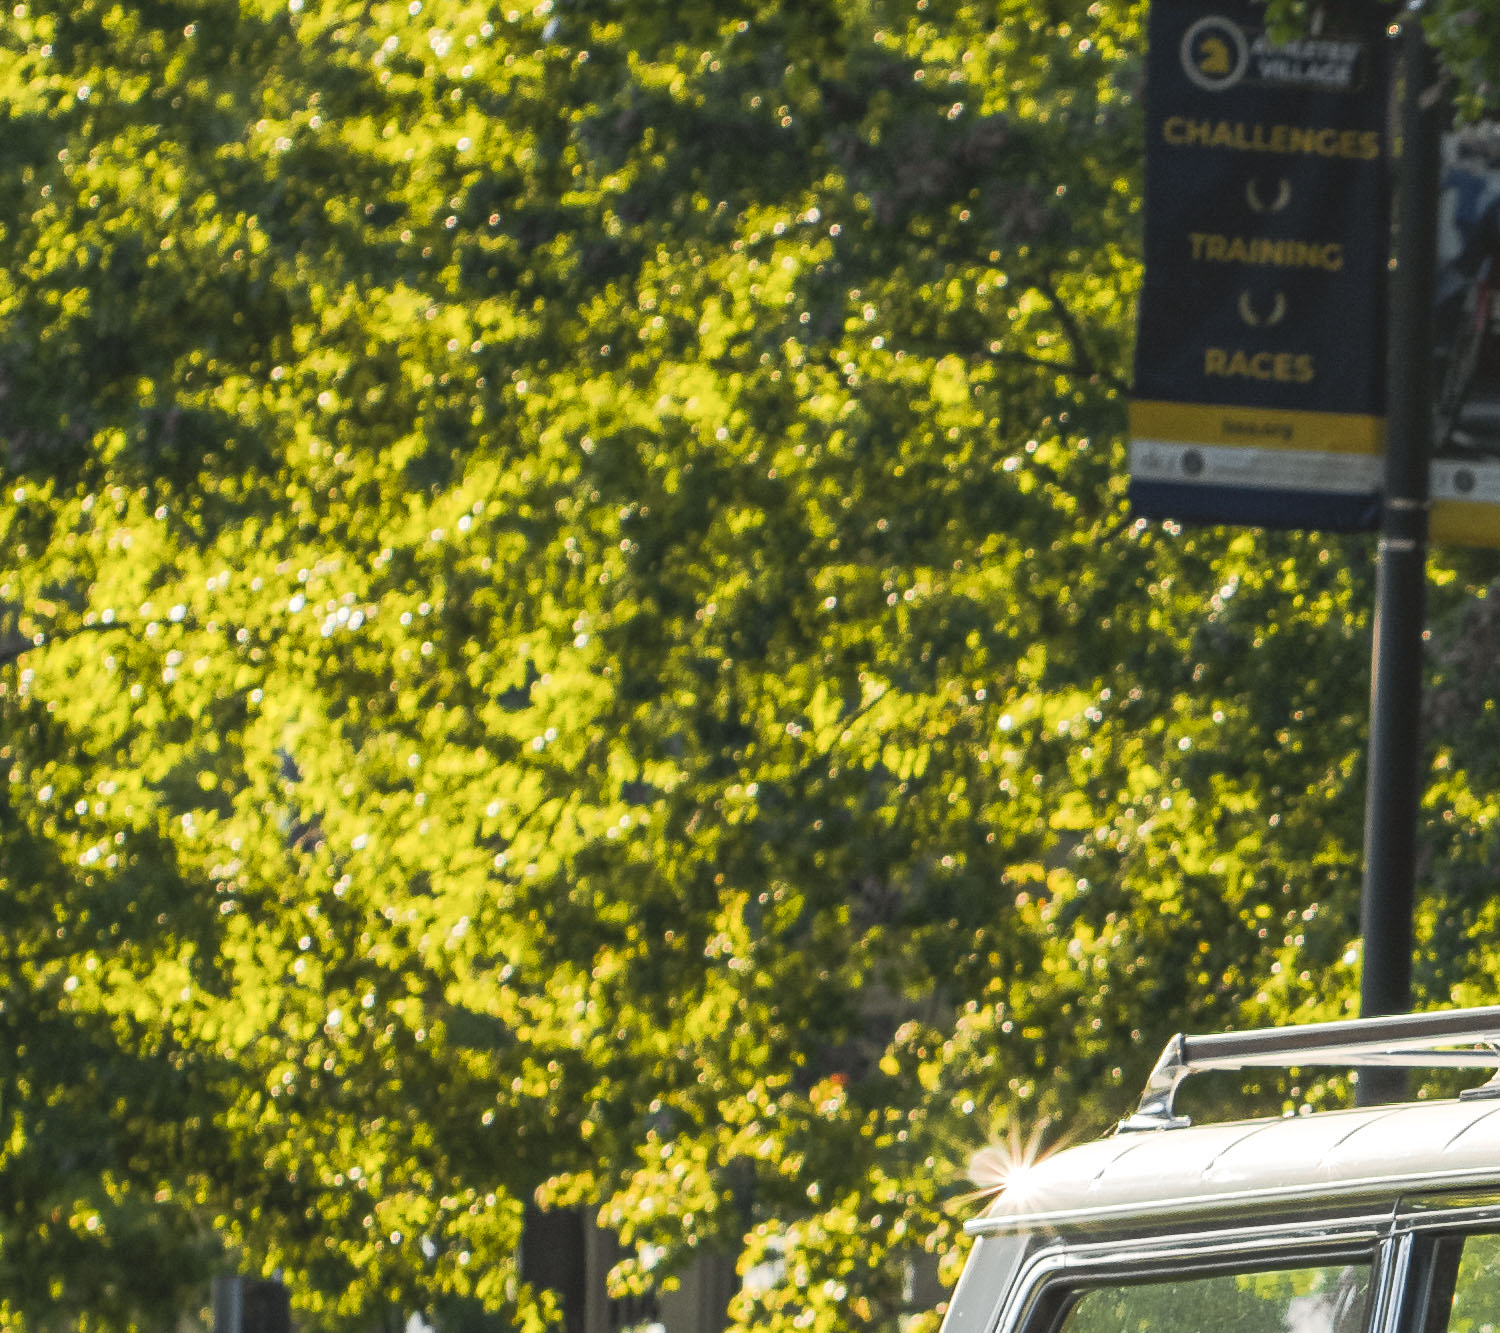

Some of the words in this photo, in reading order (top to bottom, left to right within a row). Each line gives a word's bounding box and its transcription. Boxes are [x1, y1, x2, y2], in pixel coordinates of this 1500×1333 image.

[1257, 60, 1351, 85] VILLAGE
[1163, 116, 1379, 160] CHALLENGES
[1190, 232, 1343, 271] TRAINING
[1204, 348, 1314, 383] RACES
